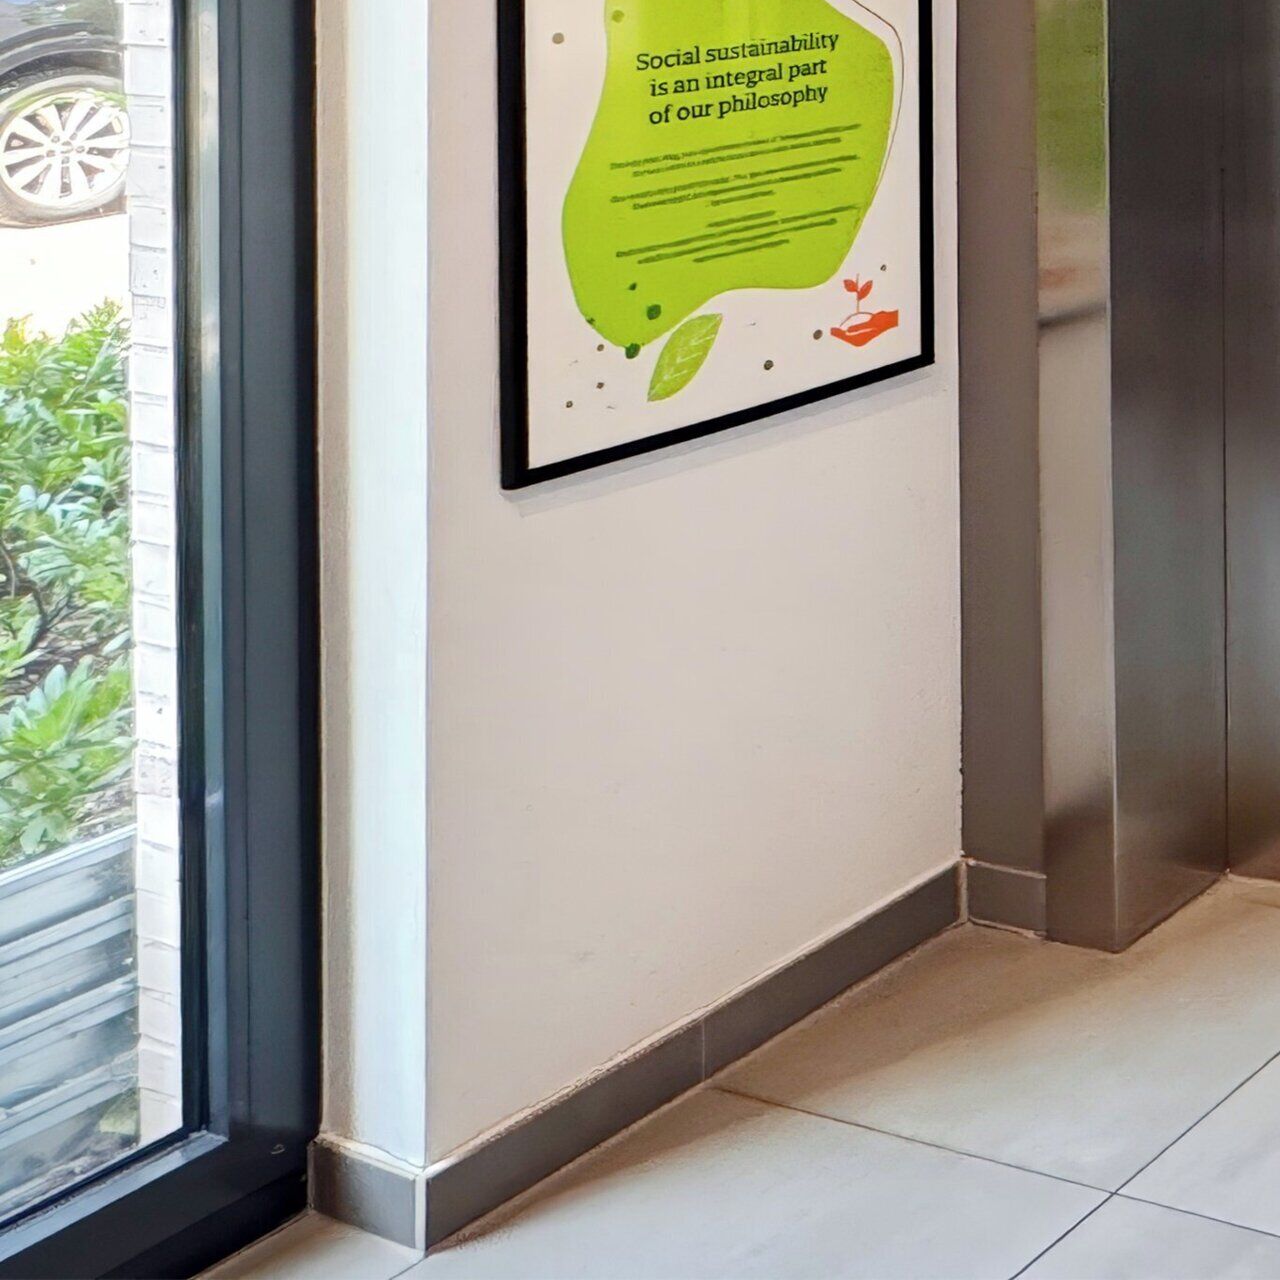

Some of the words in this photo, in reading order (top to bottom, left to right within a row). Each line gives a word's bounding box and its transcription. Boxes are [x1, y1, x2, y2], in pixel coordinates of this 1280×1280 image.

[636, 46, 700, 71] Social
[704, 32, 839, 64] sustainability
[650, 79, 668, 97] is
[673, 78, 700, 94] an
[705, 63, 782, 88] integral
[788, 58, 827, 82] part
[649, 104, 673, 125] of
[677, 103, 713, 121] our
[718, 85, 828, 119] philosophy
